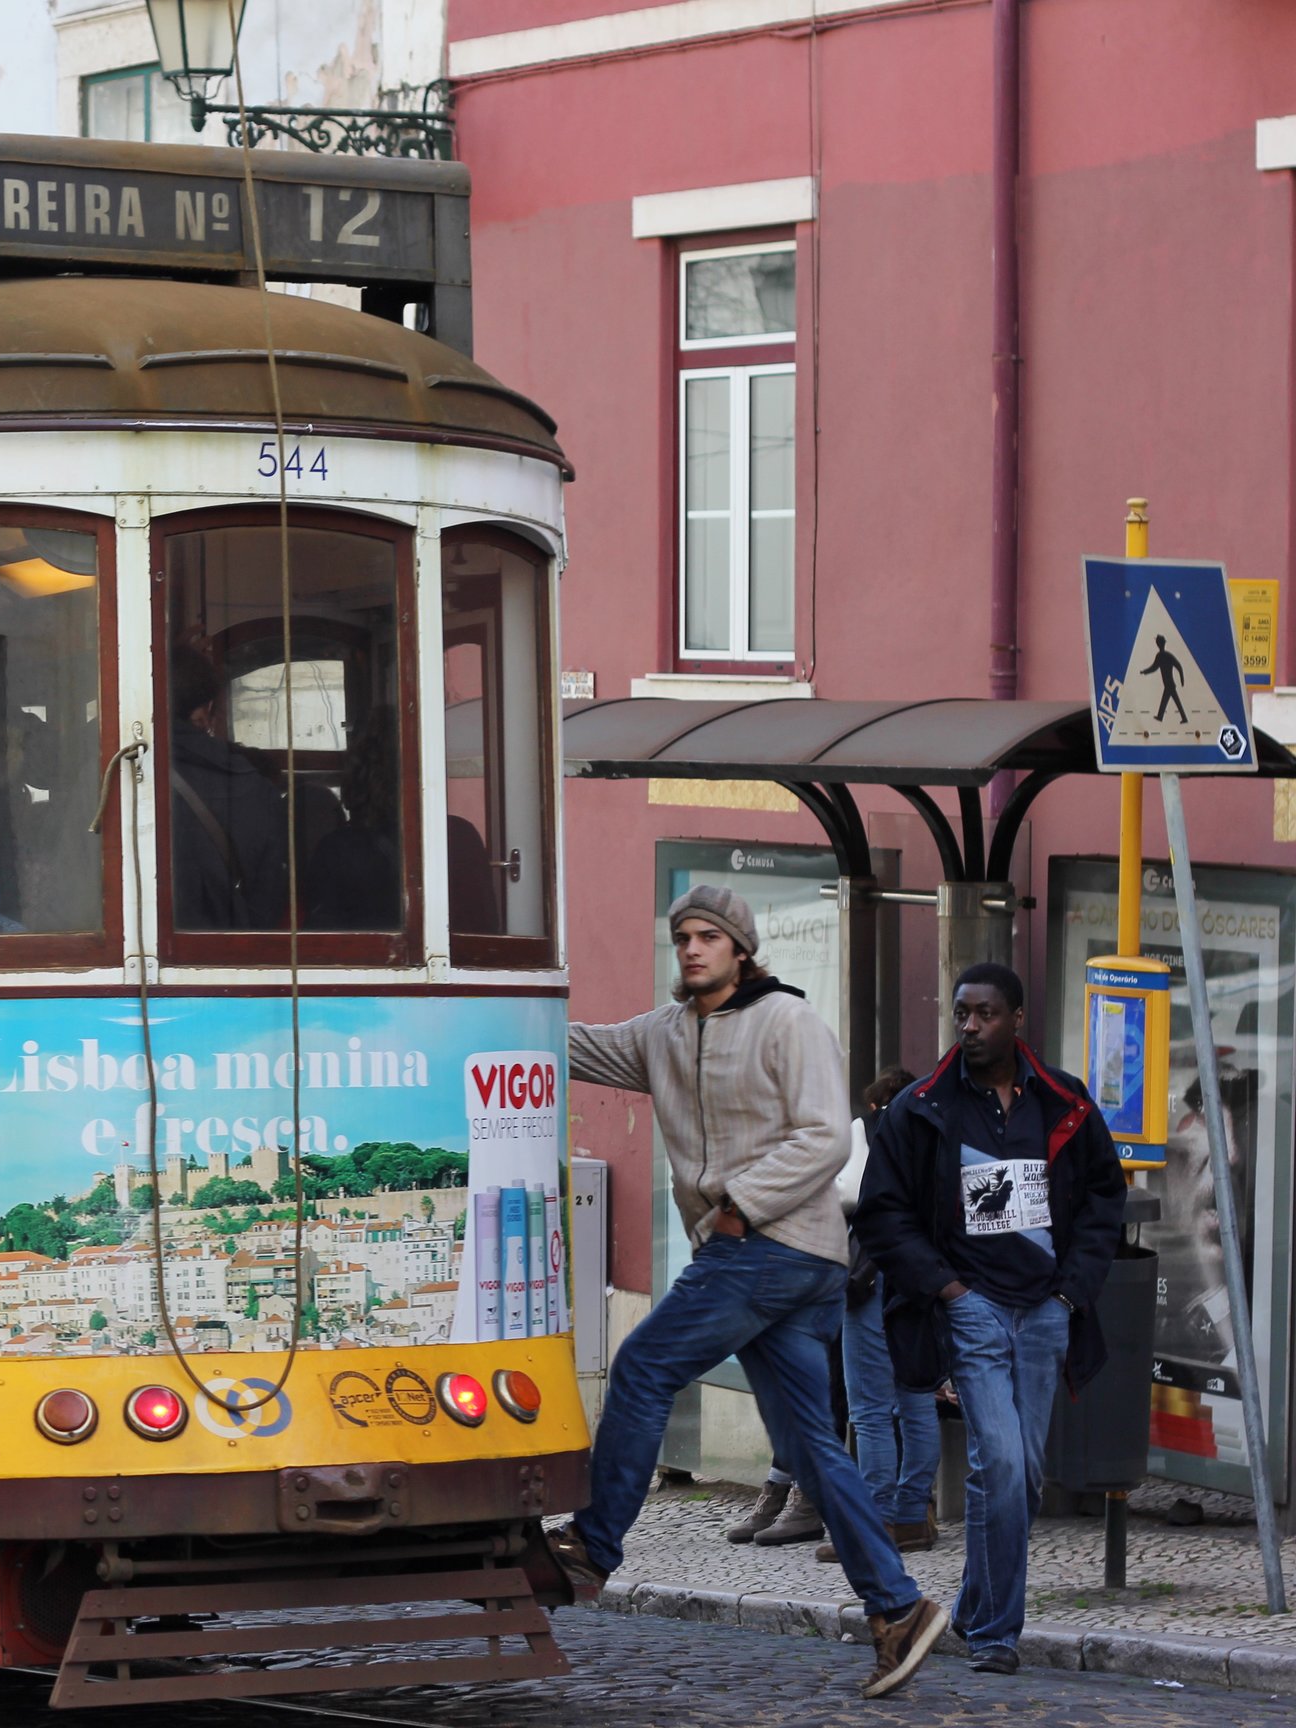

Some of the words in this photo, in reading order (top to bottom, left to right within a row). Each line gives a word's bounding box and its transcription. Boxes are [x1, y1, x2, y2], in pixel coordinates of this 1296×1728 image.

[175, 189, 230, 241] Nº
[301, 186, 381, 246] 12
[258, 442, 328, 480] 544
[1244, 655, 1267, 666] 3599
[1098, 675, 1123, 733] APS
[767, 903, 830, 943] barral
[1087, 904, 1158, 930] CAHO
[1203, 909, 1276, 940] ÓSCARES
[1109, 974, 1138, 985] Operário
[1162, 955, 1186, 967] CINE
[211, 1036, 430, 1090] menina
[471, 1063, 555, 1109] VIGOR
[81, 1117, 117, 1156] e
[134, 1102, 349, 1156] fresca.
[472, 1117, 518, 1139] SEMPRE
[977, 1220, 1011, 1231] COLLEGE
[339, 1393, 375, 1407] apcer
